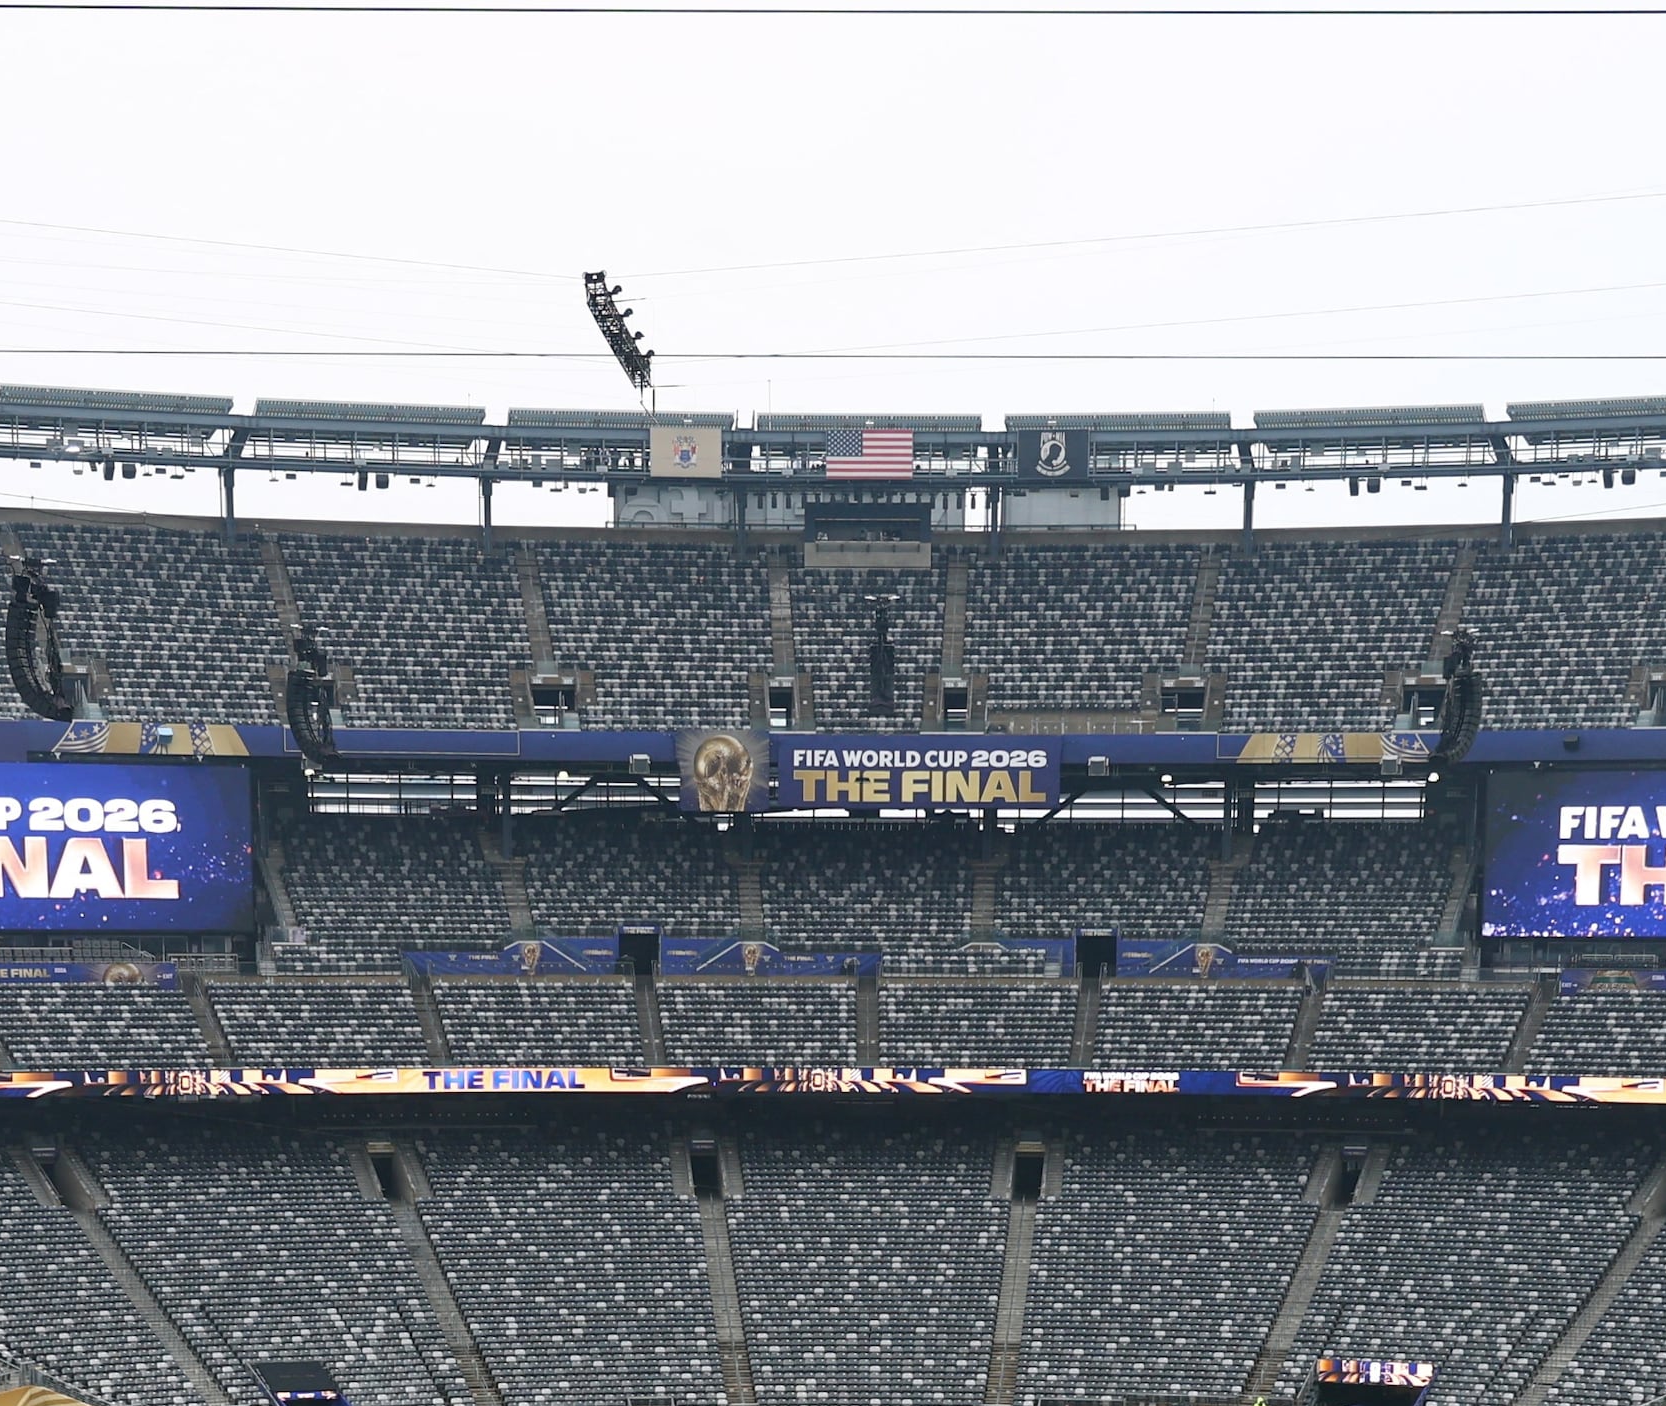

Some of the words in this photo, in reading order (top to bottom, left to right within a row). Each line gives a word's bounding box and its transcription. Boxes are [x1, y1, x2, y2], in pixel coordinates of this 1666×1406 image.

[793, 750, 841, 768] FIFA
[842, 750, 919, 768] WORLD
[924, 750, 967, 768] CUP
[971, 750, 1047, 768] 2026
[794, 770, 891, 803] THE
[901, 770, 1047, 803] FINAL
[27, 797, 178, 833] 2026
[1558, 805, 1650, 840] FIFA
[11, 969, 51, 979] FINAL
[422, 1071, 484, 1090] THE
[492, 1071, 585, 1090] FINAL
[1083, 1080, 1122, 1093] THE
[1123, 1080, 1180, 1093] FINAL
